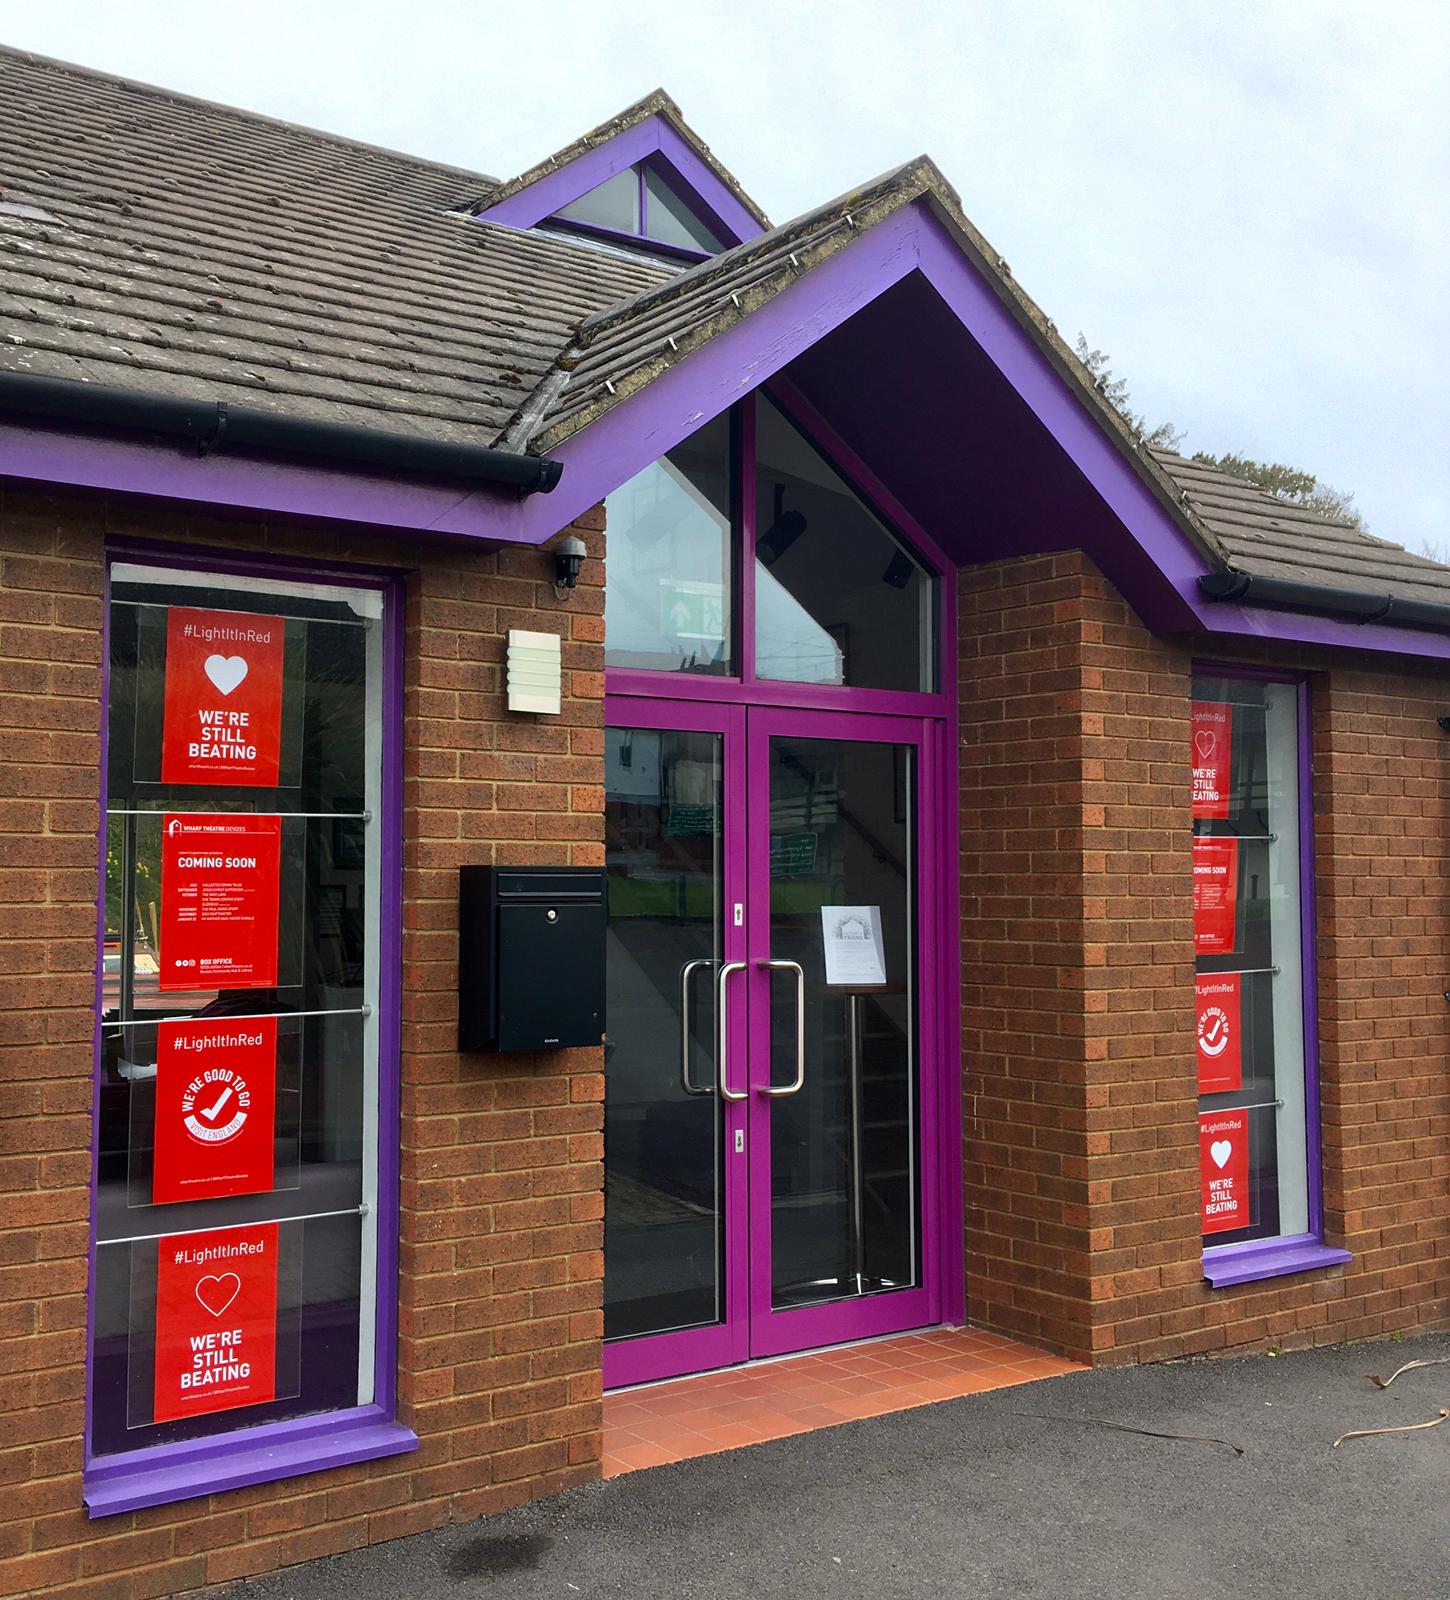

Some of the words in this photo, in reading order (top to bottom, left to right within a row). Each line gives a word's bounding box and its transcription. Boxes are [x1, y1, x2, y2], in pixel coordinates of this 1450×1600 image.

[183, 624, 271, 643] #LightItInRed
[198, 709, 249, 726] WE'RE
[201, 727, 245, 742] STILL
[188, 743, 257, 760] BEATING
[1193, 779, 1215, 790] STILL
[1191, 791, 1219, 801] EATING
[178, 857, 223, 868] COMING
[225, 857, 256, 868] SOON
[1212, 866, 1227, 874] SOON
[174, 1033, 263, 1052] #LightItInRed
[203, 1068, 234, 1083] GOOD
[231, 1075, 246, 1091] TO
[182, 1076, 205, 1112] WE'RE
[238, 1091, 250, 1107] GO
[190, 1121, 207, 1138] VISIT
[207, 1119, 241, 1139] ENGLAND
[1200, 1120, 1242, 1135] #LightItInRed
[1211, 1191, 1232, 1202] STILL
[1205, 1200, 1238, 1215] BEATING
[174, 1240, 264, 1265] #LightItInRed
[190, 1329, 242, 1352] WE'RE
[193, 1348, 239, 1369] STILL
[180, 1362, 251, 1389] BEATING
